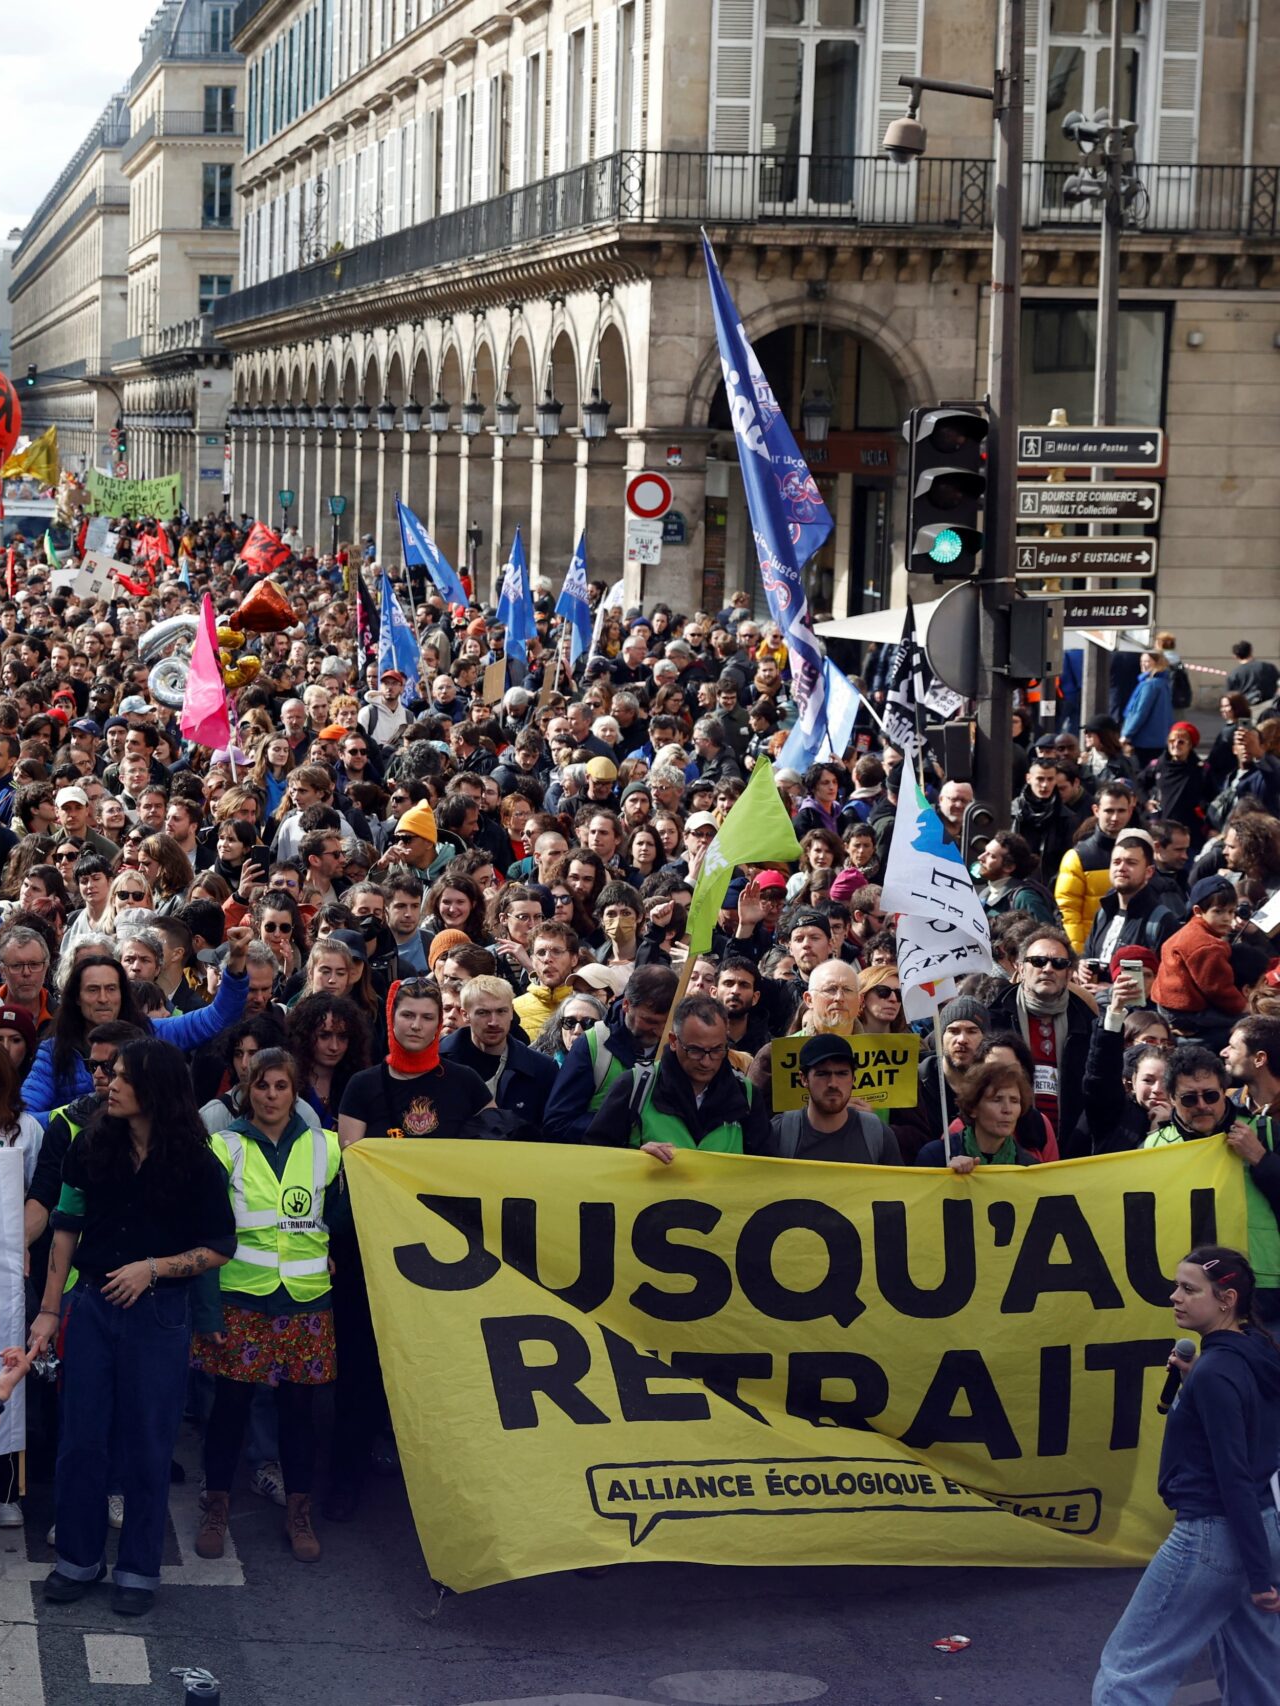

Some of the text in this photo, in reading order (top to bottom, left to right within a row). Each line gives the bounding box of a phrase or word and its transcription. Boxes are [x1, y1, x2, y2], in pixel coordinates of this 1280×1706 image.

[1056, 443, 1080, 452] Hôtel
[1082, 443, 1097, 452] des
[1100, 443, 1129, 452] Postes
[1040, 491, 1137, 502] BOURSE DE COMMERCE
[1040, 505, 1118, 515] PINAULT Collection
[635, 537, 653, 545] SAUF
[1038, 551, 1068, 564] Église
[1083, 552, 1133, 563] EUSTACHE
[1071, 607, 1088, 617] des
[1091, 606, 1129, 617] HALLES
[781, 1050, 909, 1069] JU'AU
[790, 1069, 900, 1089] RAIT
[393, 1187, 1220, 1329] JUSQU'AU
[480, 1314, 1176, 1461] RETRAIT
[607, 1473, 755, 1502] ALLIANCE
[765, 1468, 937, 1499] ÉCOLOGIQUE
